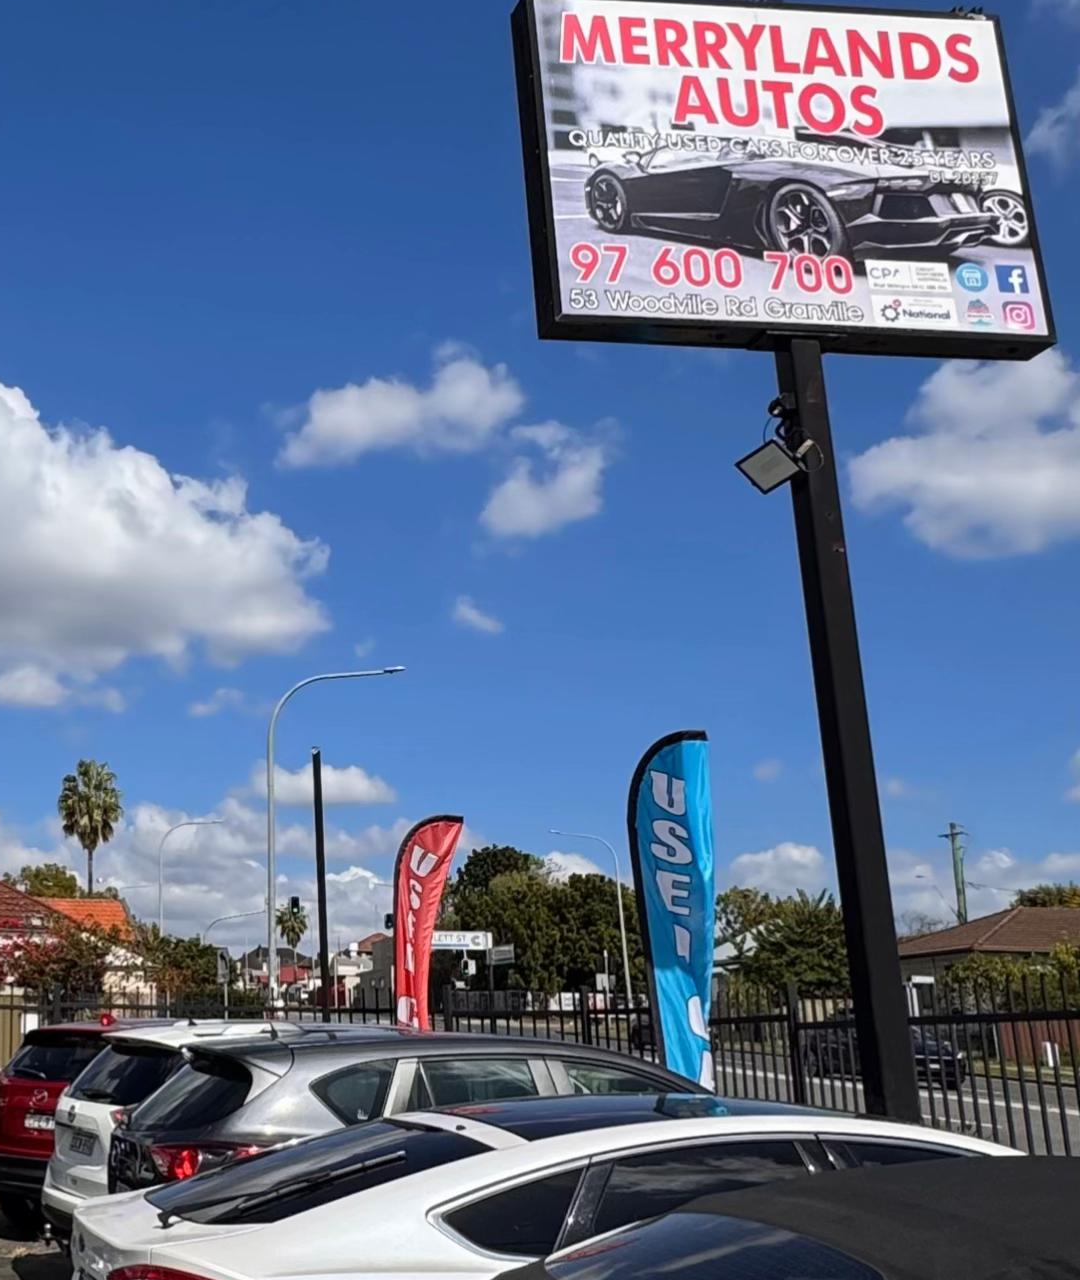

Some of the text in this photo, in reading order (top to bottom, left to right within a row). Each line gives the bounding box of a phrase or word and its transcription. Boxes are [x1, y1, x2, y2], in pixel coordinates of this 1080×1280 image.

[560, 13, 980, 83] MERRYLANDS
[674, 75, 884, 136] AUTOS
[568, 129, 659, 151] QUALITY
[667, 134, 721, 152] USED
[729, 137, 783, 157] CARS
[788, 141, 831, 161] FOR
[835, 144, 893, 166] OVER
[929, 150, 996, 169] YEARS
[570, 242, 854, 296] 97 600 700
[569, 289, 864, 322] 53 Woodville Rd Granville
[902, 308, 951, 320] National
